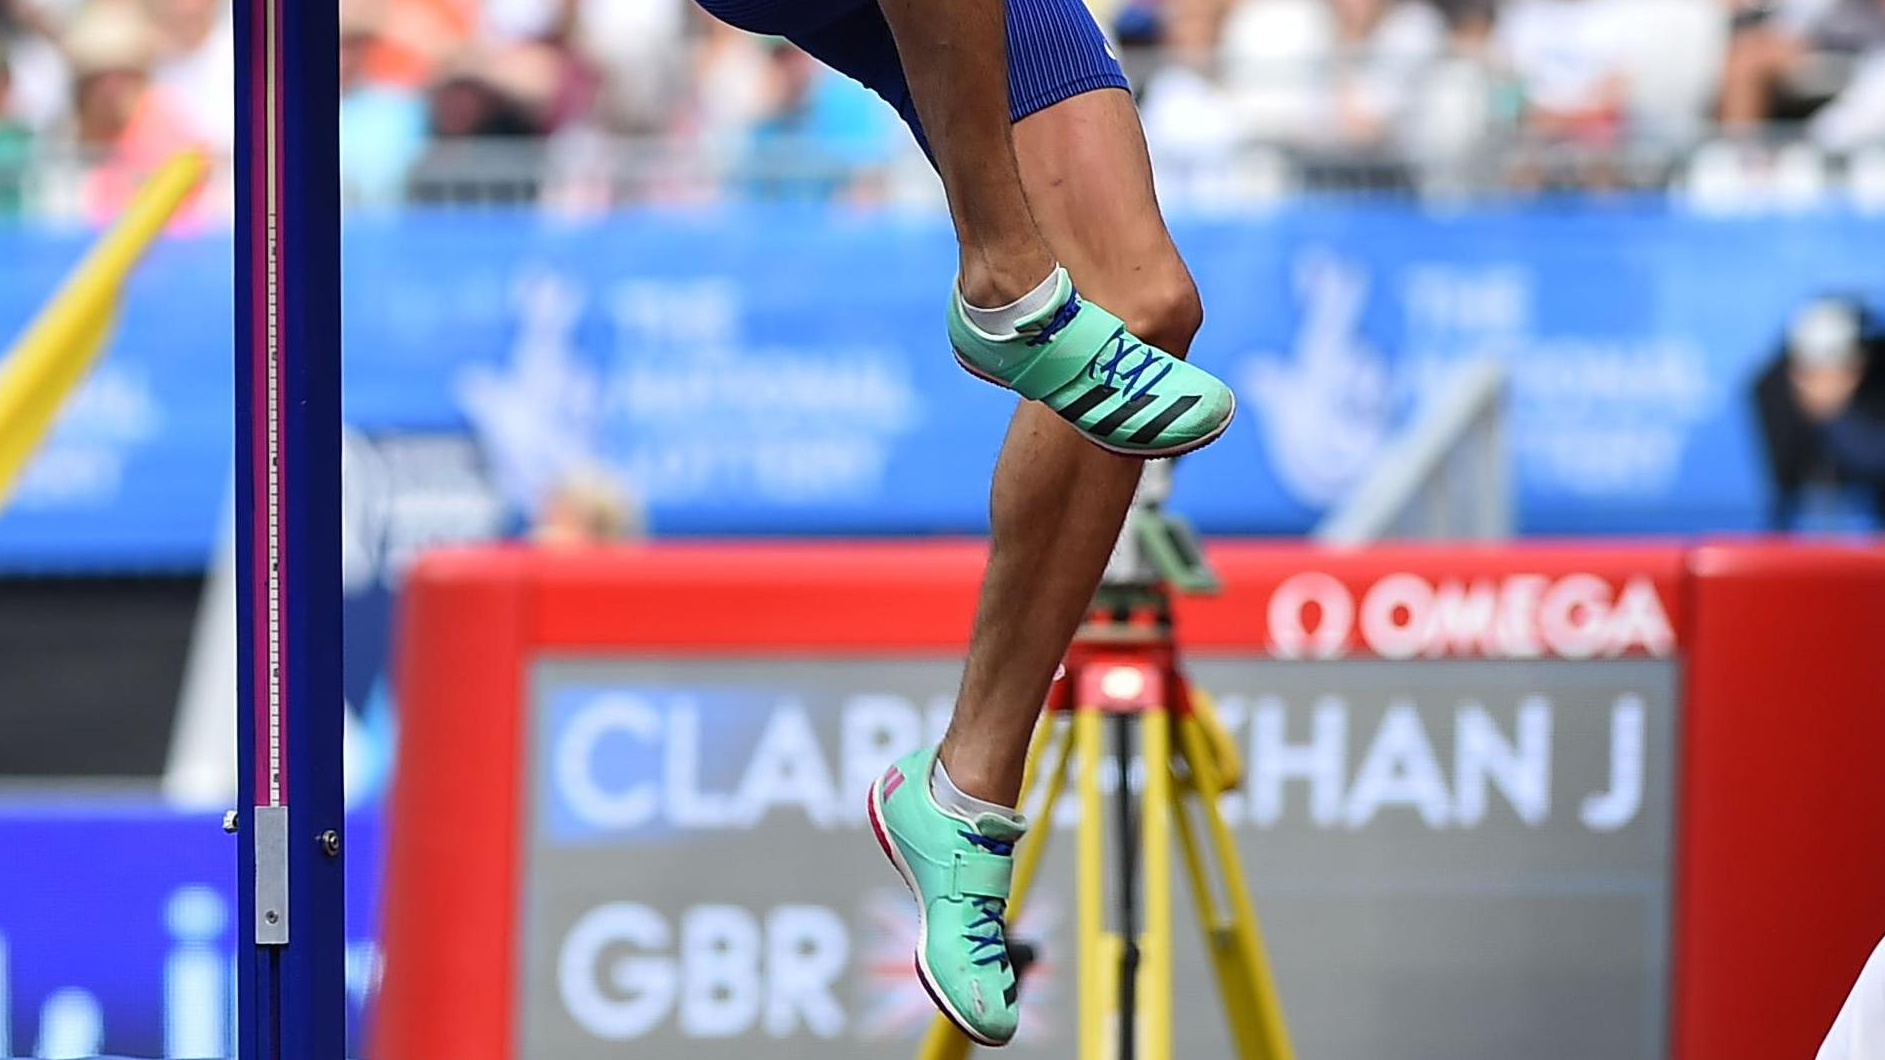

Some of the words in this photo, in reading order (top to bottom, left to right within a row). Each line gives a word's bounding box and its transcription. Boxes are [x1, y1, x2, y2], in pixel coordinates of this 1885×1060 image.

[1359, 570, 1678, 661] OMEGA
[1580, 691, 1646, 830] J
[558, 901, 849, 1038] GBR
